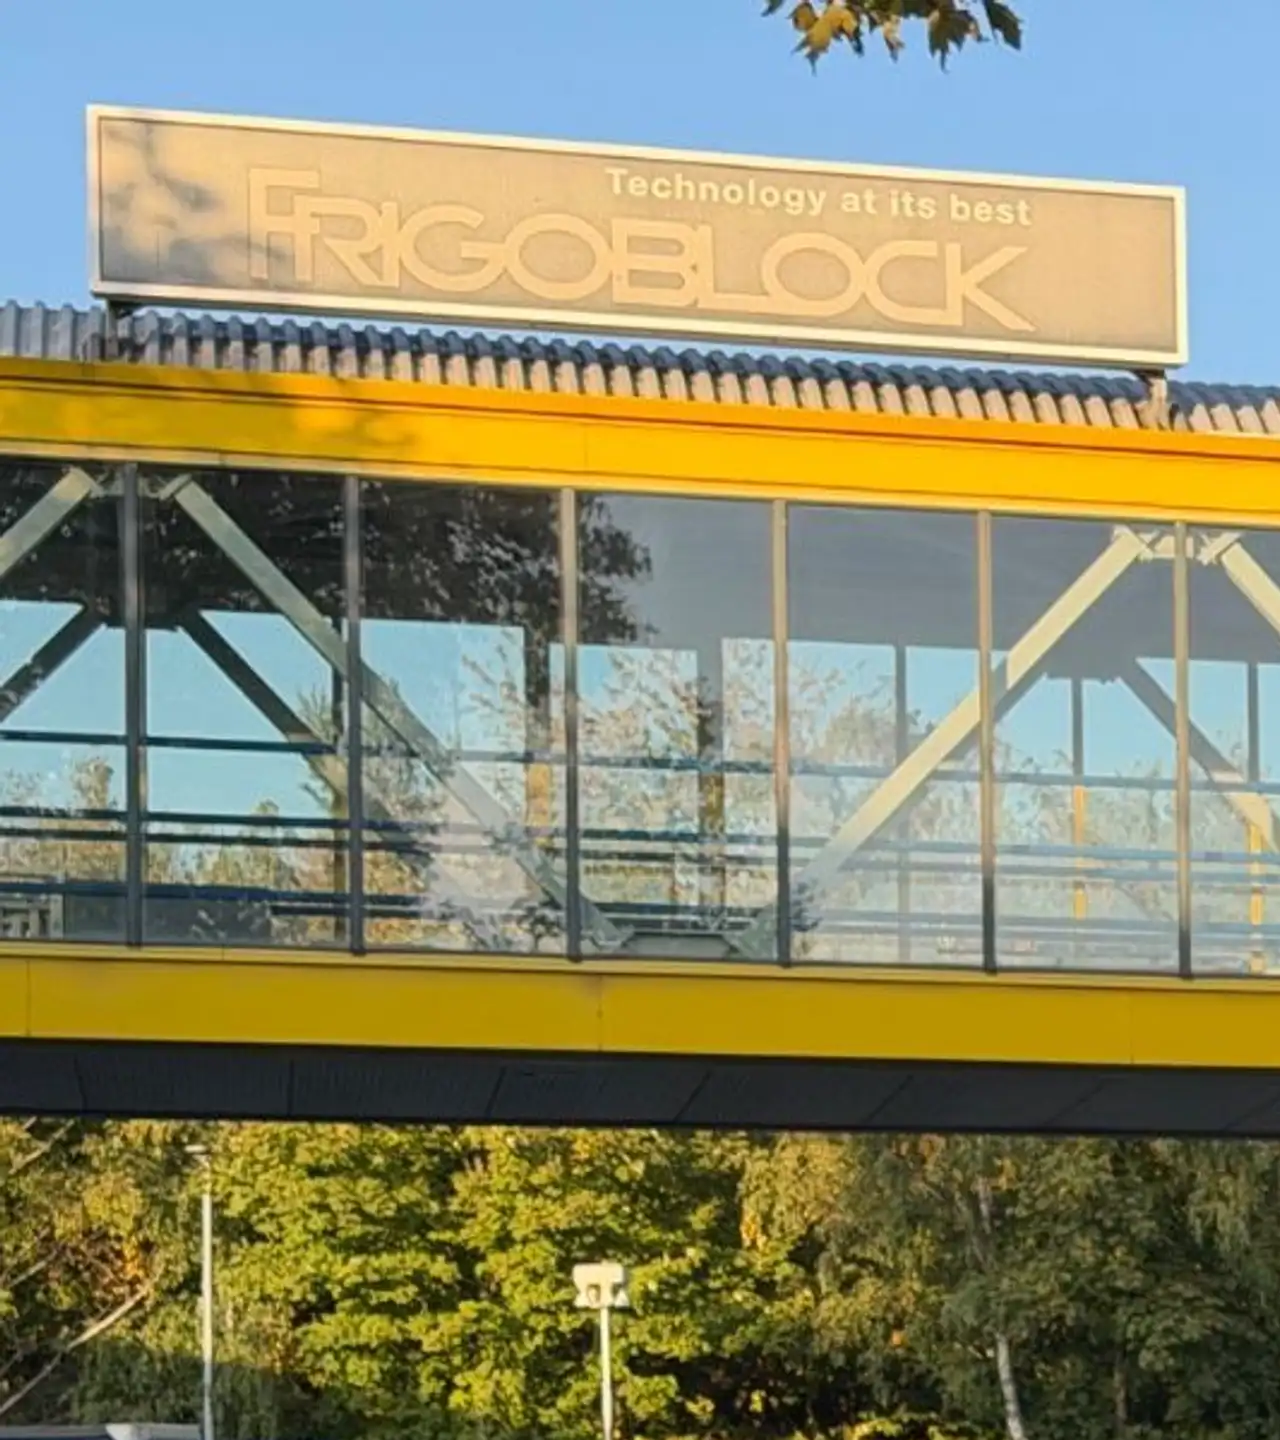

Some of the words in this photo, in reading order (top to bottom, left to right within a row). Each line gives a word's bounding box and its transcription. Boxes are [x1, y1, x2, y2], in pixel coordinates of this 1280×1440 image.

[248, 167, 1037, 332] FRIGOBLOCK
[604, 166, 828, 217] Technology
[840, 187, 878, 215] at
[890, 188, 937, 220] its
[949, 192, 1033, 226] best
